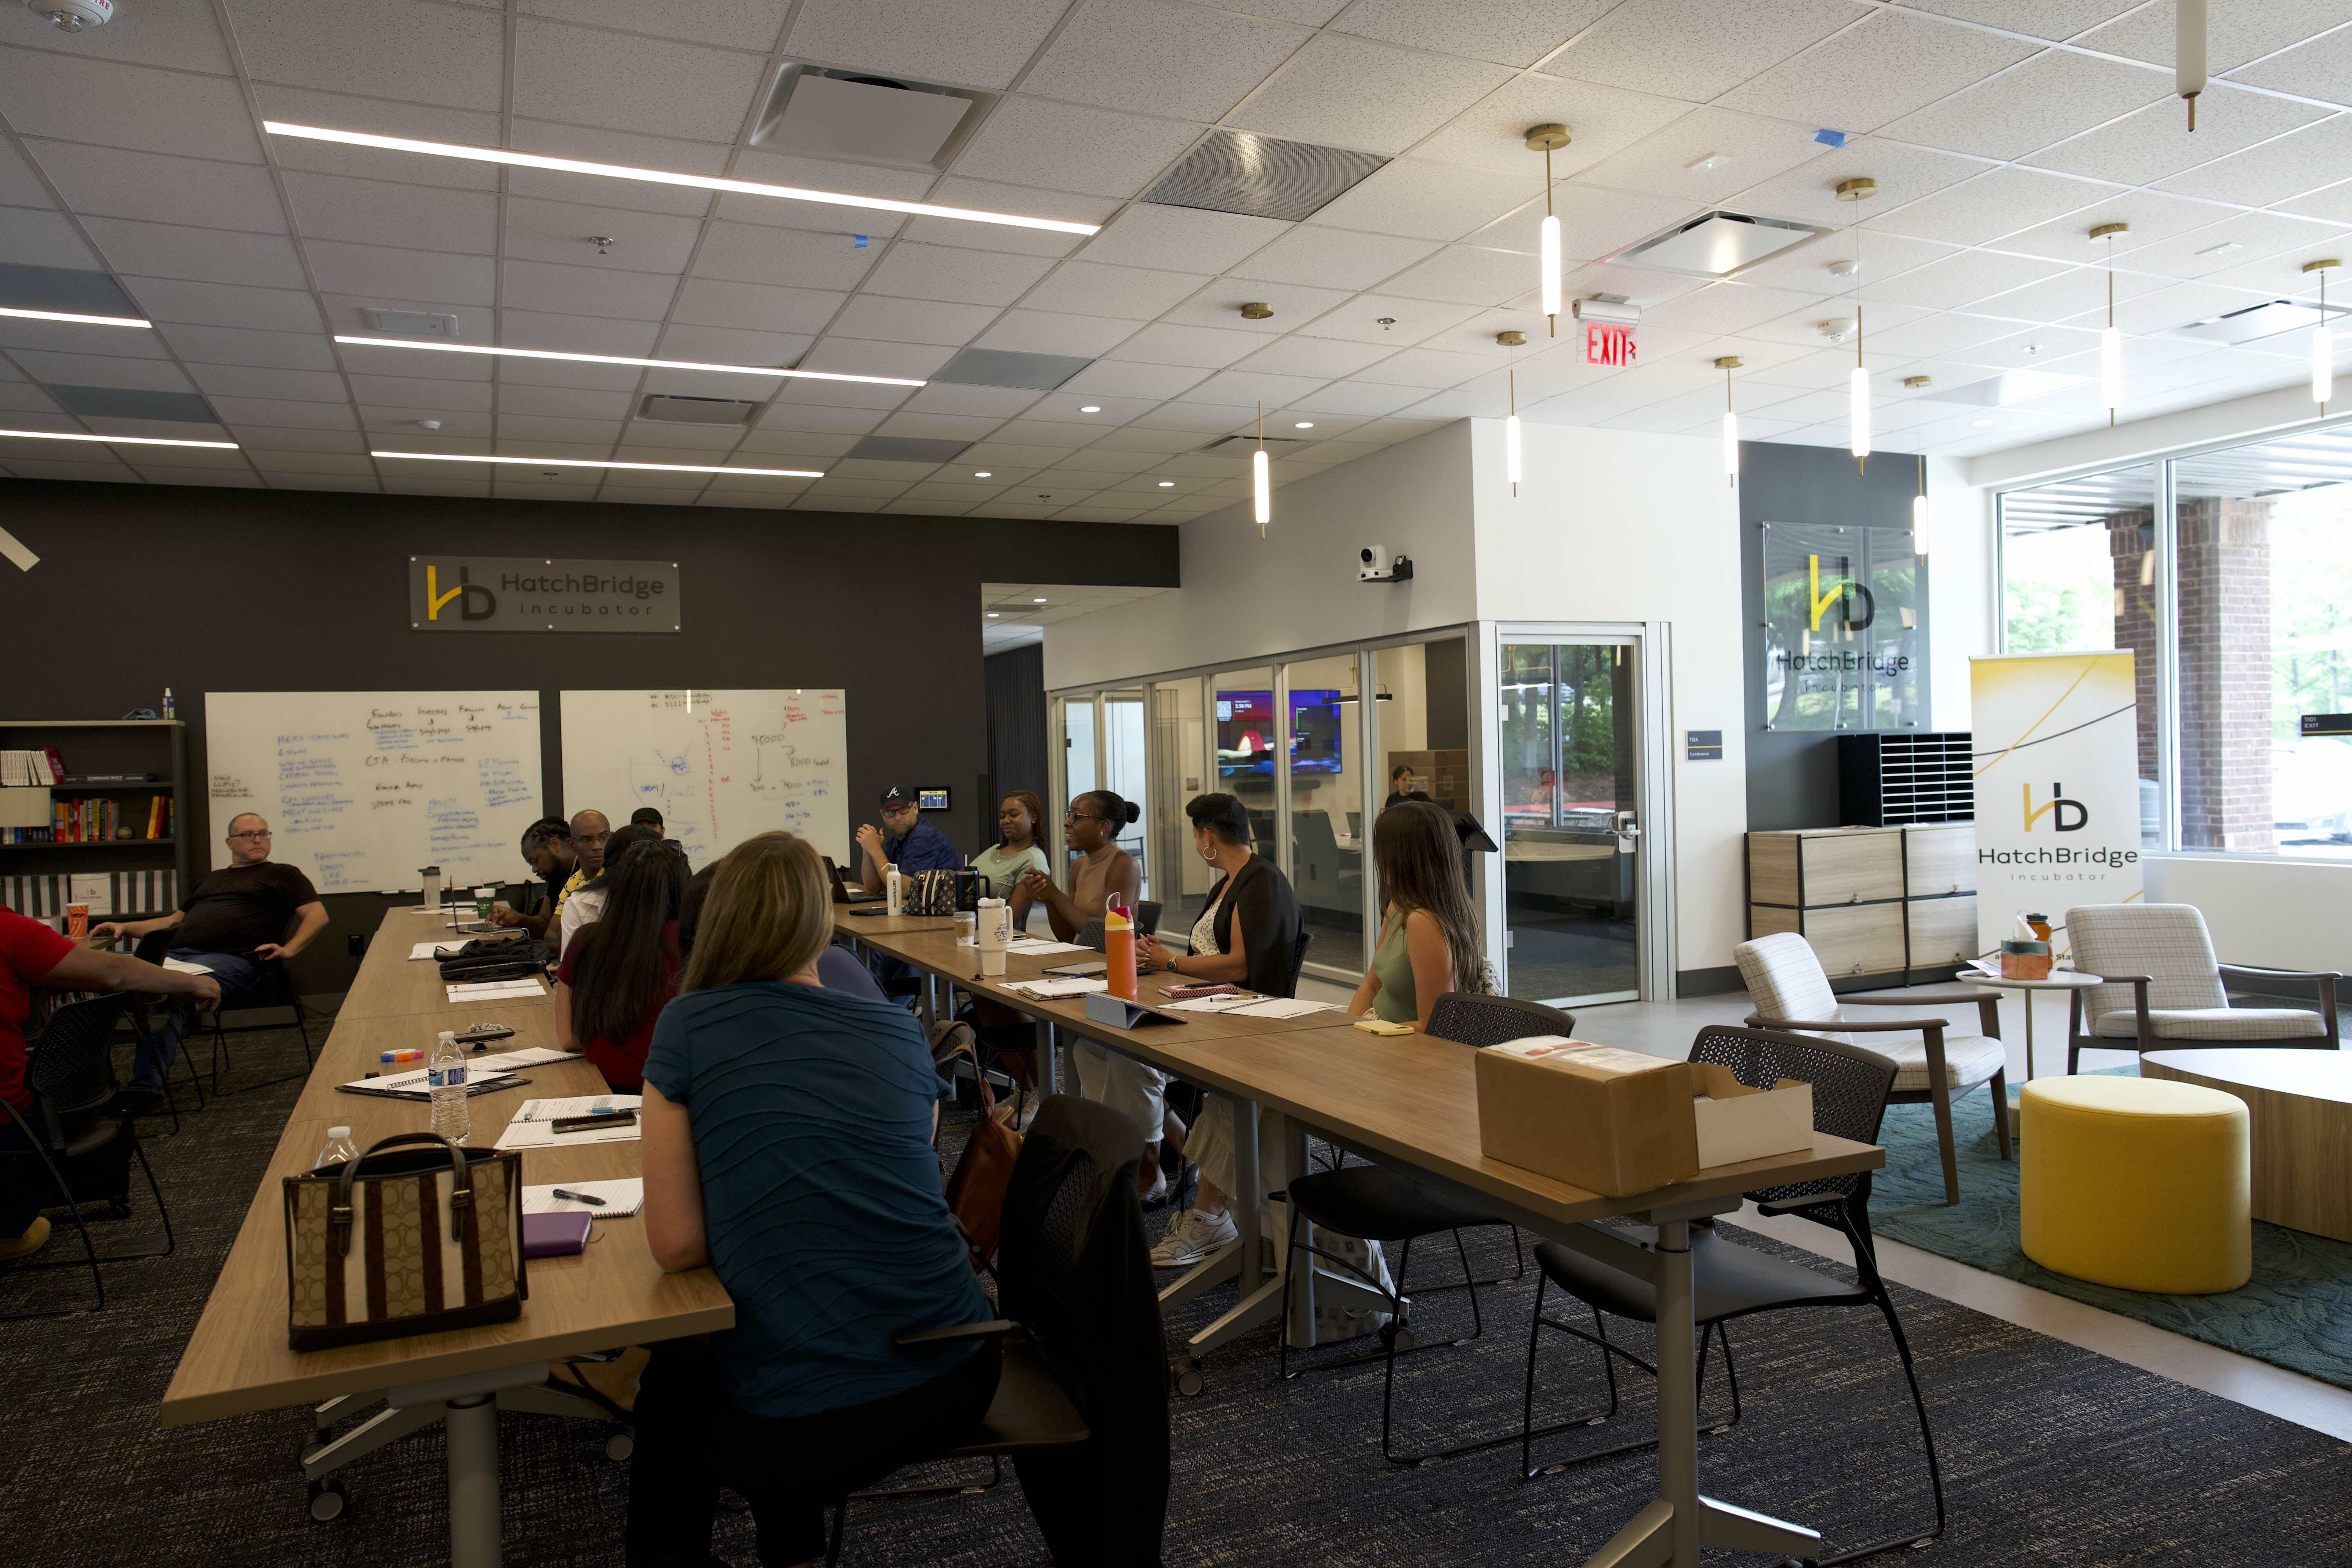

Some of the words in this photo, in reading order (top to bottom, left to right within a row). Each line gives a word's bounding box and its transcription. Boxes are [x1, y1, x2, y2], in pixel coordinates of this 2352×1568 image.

[1587, 321, 1631, 367] EXIT
[502, 573, 664, 599] HatchBridge
[520, 603, 652, 615] incubator
[1777, 650, 1909, 677] HatchBridge
[1805, 682, 1884, 693] incubator
[887, 787, 899, 798] A
[1979, 847, 2138, 868] HatchBridge
[2011, 873, 2106, 881] incubator
